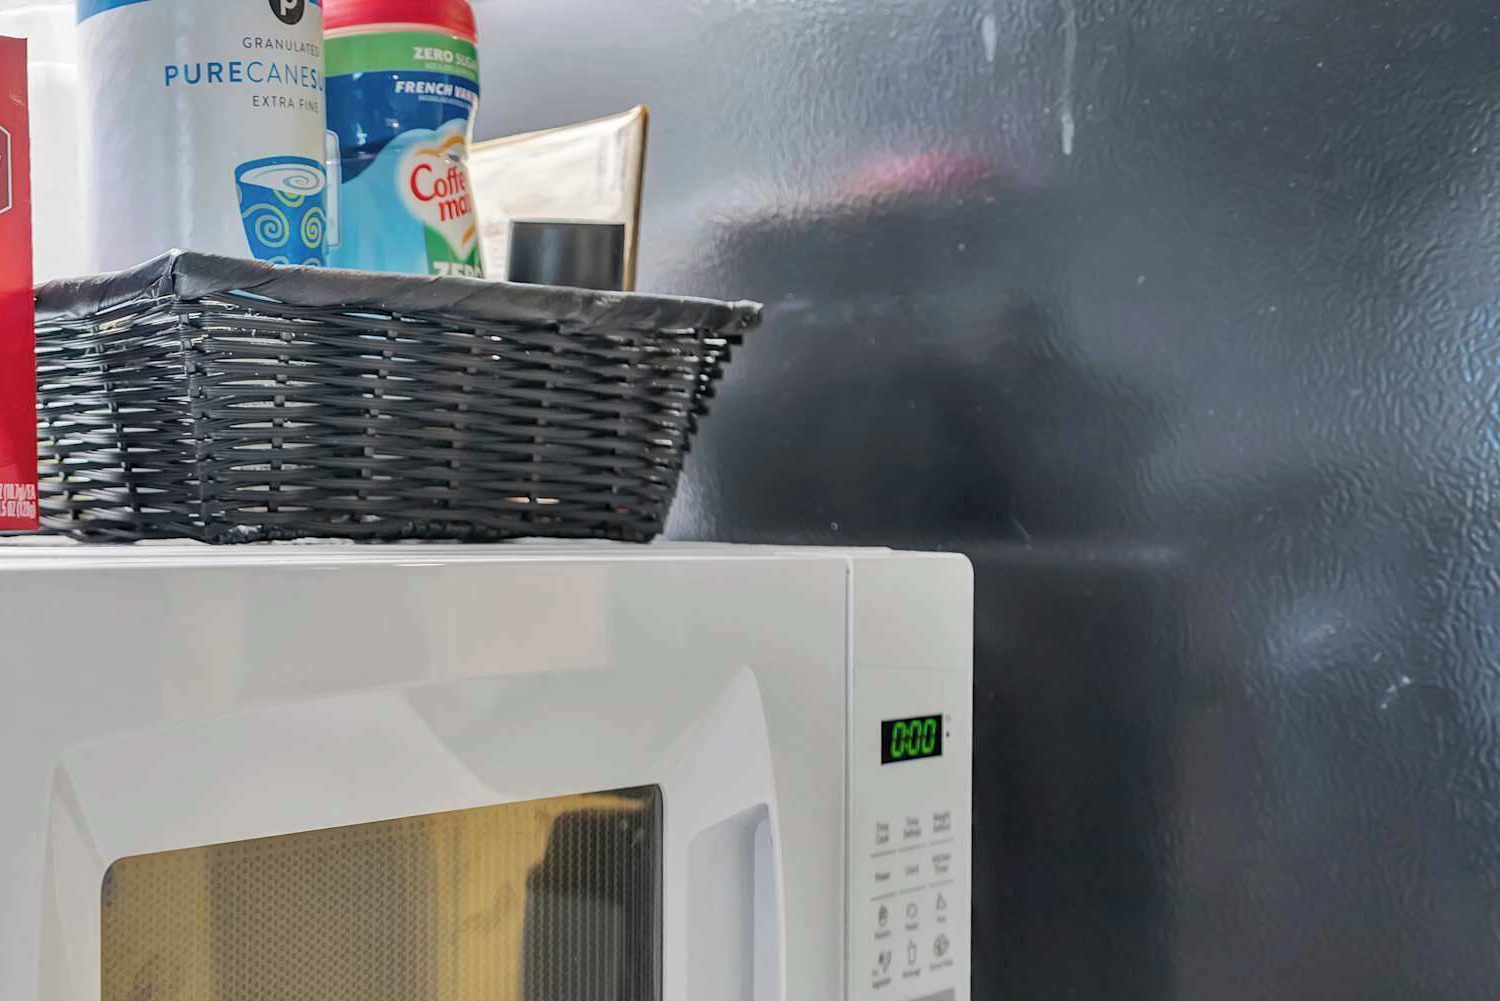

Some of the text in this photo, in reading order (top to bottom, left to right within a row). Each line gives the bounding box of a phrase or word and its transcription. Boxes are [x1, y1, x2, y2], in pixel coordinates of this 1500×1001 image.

[242, 37, 320, 57] GRANULATED
[414, 47, 454, 62] ZERO
[164, 61, 324, 92] PURECANESU
[395, 81, 453, 96] FRENCH
[252, 96, 319, 114] EXTRA FINE
[410, 162, 466, 202] Coffe
[438, 194, 472, 222] ma
[890, 718, 936, 758] 0:00
